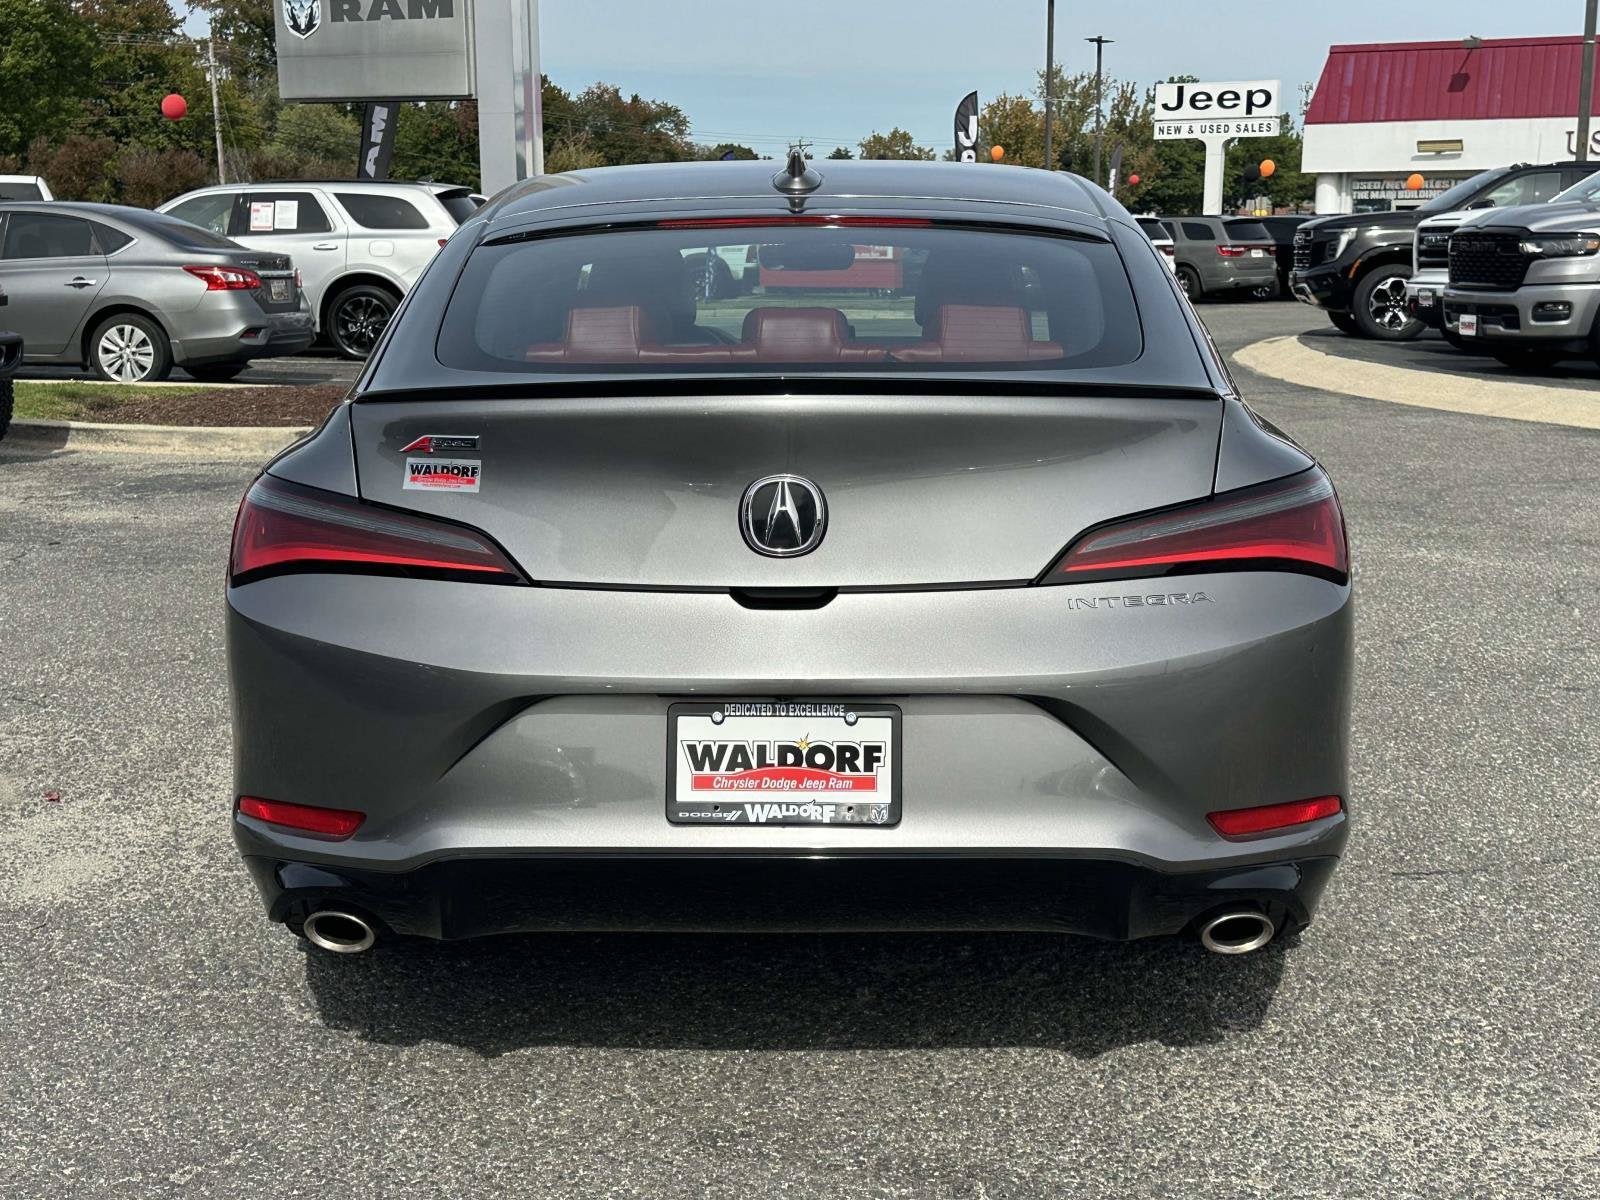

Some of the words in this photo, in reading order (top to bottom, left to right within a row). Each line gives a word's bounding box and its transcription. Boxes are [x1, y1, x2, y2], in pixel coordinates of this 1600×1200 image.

[330, 0, 454, 23] RAM
[1161, 85, 1272, 116] Jeep
[1158, 125, 1182, 135] NEW
[1187, 125, 1194, 135] &
[1200, 124, 1230, 134] USED
[1235, 123, 1272, 133] SALES
[1353, 190, 1369, 200] THE
[1370, 190, 1397, 200] MAIN
[410, 464, 479, 478] WALDORF
[1067, 591, 1216, 610] INTEGRA
[724, 703, 774, 716] DEDICATED
[776, 703, 787, 716] TO
[789, 704, 845, 716] EXCELLENCE
[684, 742, 884, 773] WALDORF
[713, 777, 761, 790] Chrysler
[761, 777, 797, 790] Dodge
[799, 777, 827, 790] Jeep
[828, 777, 853, 789] Ram
[744, 803, 836, 823] WALDORF
